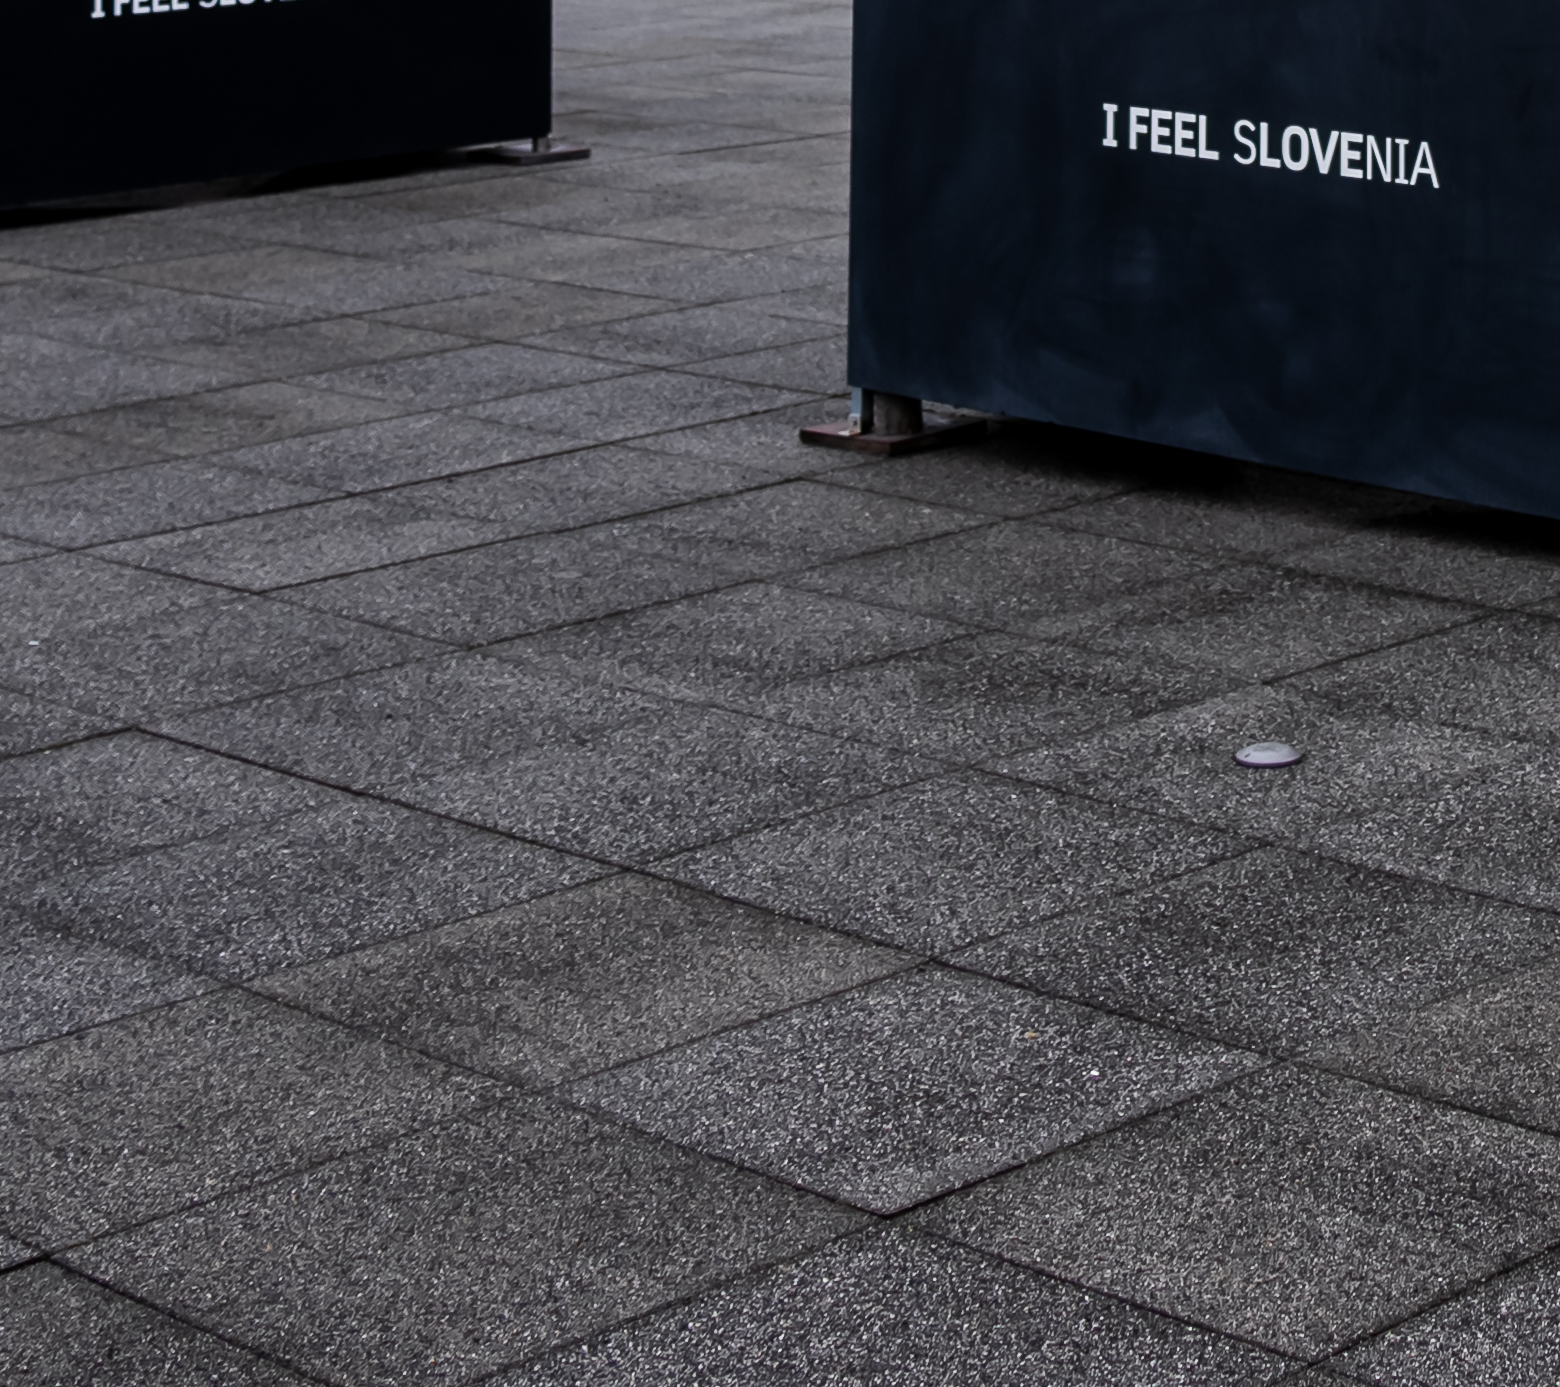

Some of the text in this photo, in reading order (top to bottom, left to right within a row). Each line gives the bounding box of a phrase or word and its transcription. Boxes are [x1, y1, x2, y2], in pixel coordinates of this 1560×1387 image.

[1103, 103, 1439, 188] I FEEL SLOVENIA
